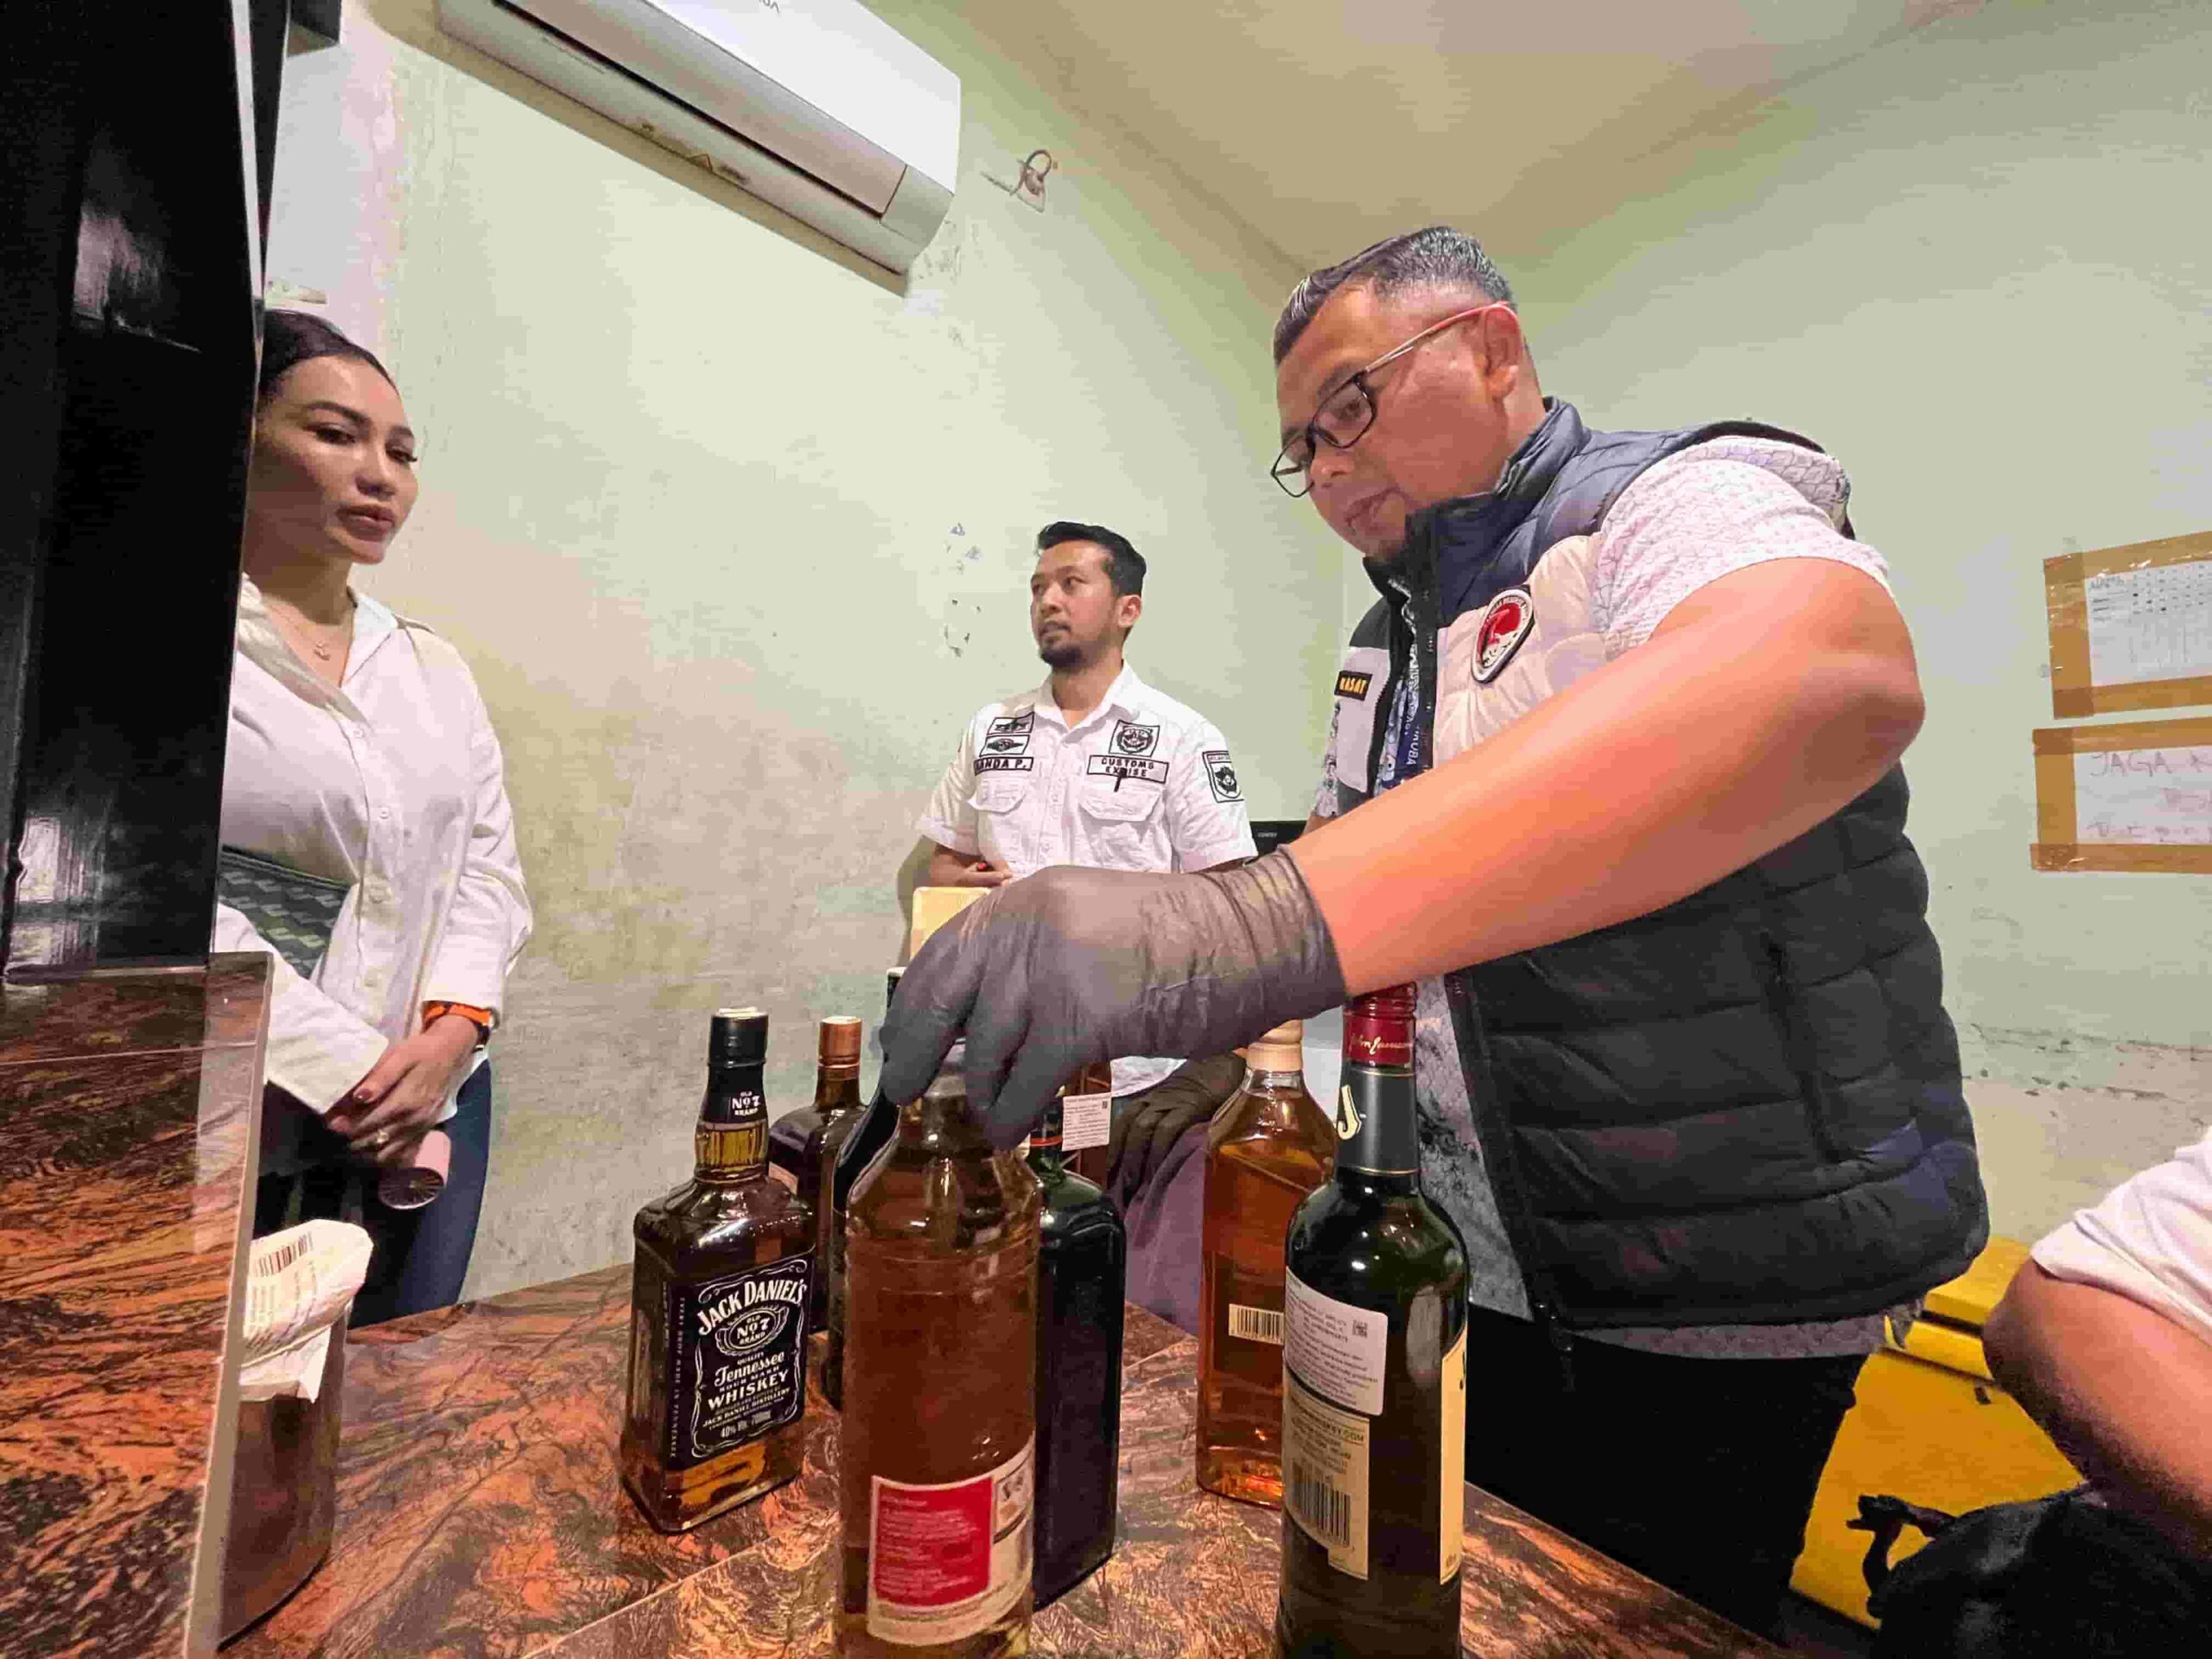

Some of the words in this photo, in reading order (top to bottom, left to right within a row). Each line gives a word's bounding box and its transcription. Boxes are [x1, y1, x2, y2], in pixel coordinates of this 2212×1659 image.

[1101, 757, 1154, 770] CUSTOMS
[1105, 766, 1148, 777] EXISE
[697, 1290, 743, 1336] JACK
[744, 1279, 808, 1307] DANIEL'S
[714, 1351, 785, 1388] Tennessee
[708, 1369, 789, 1411] WHISKEY
